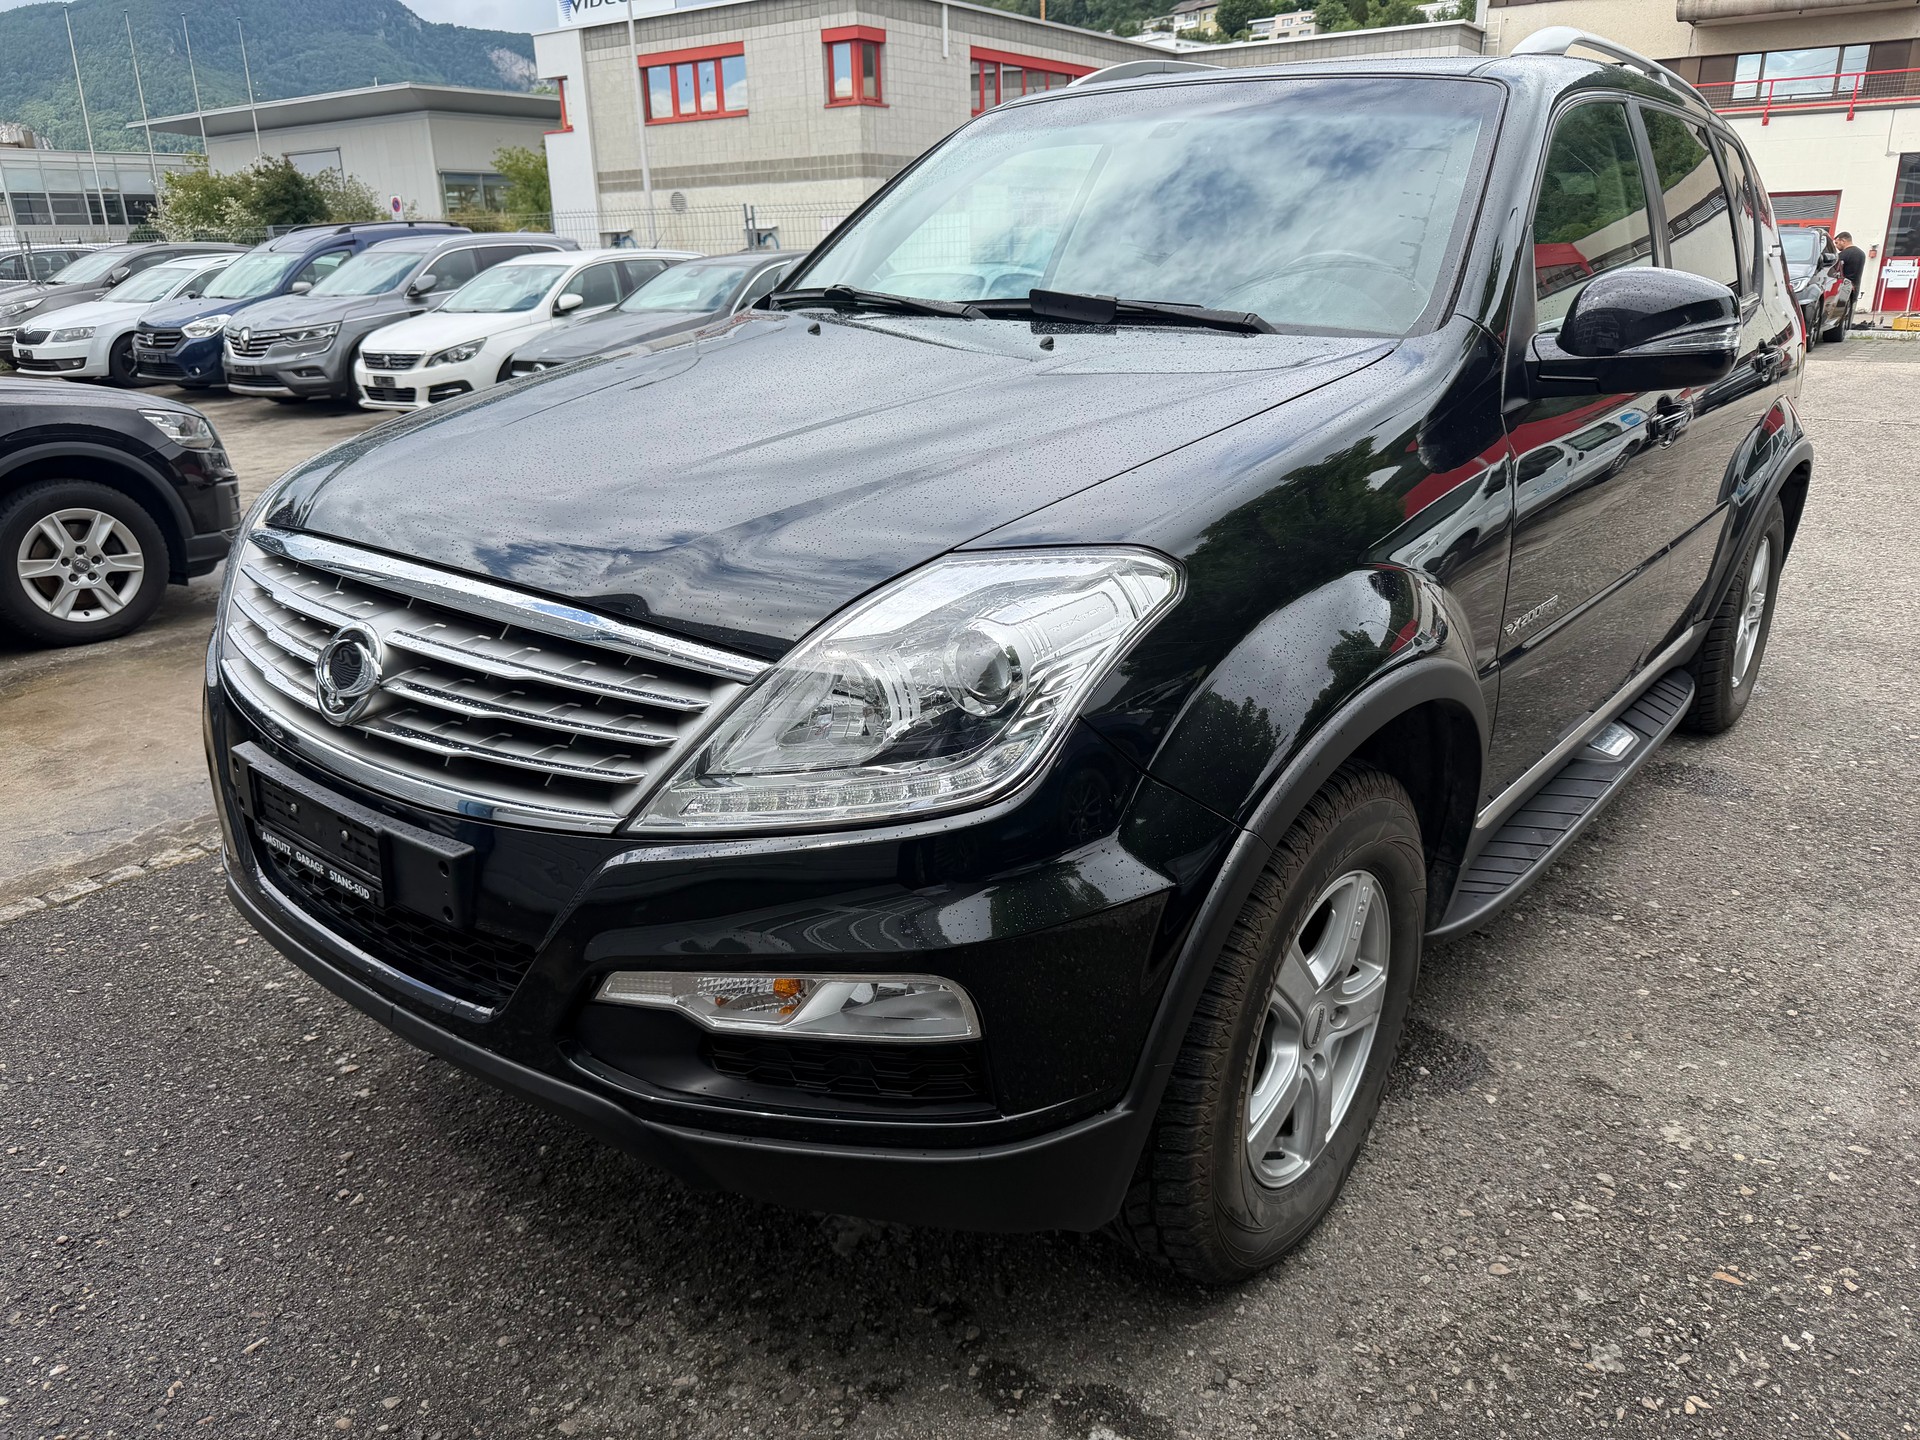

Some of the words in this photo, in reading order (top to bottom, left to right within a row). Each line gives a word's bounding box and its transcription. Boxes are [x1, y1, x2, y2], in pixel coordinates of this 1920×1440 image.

[571, 0, 628, 13] VID
[262, 831, 292, 856] AMSTUTZ
[295, 851, 325, 875] GARAGE
